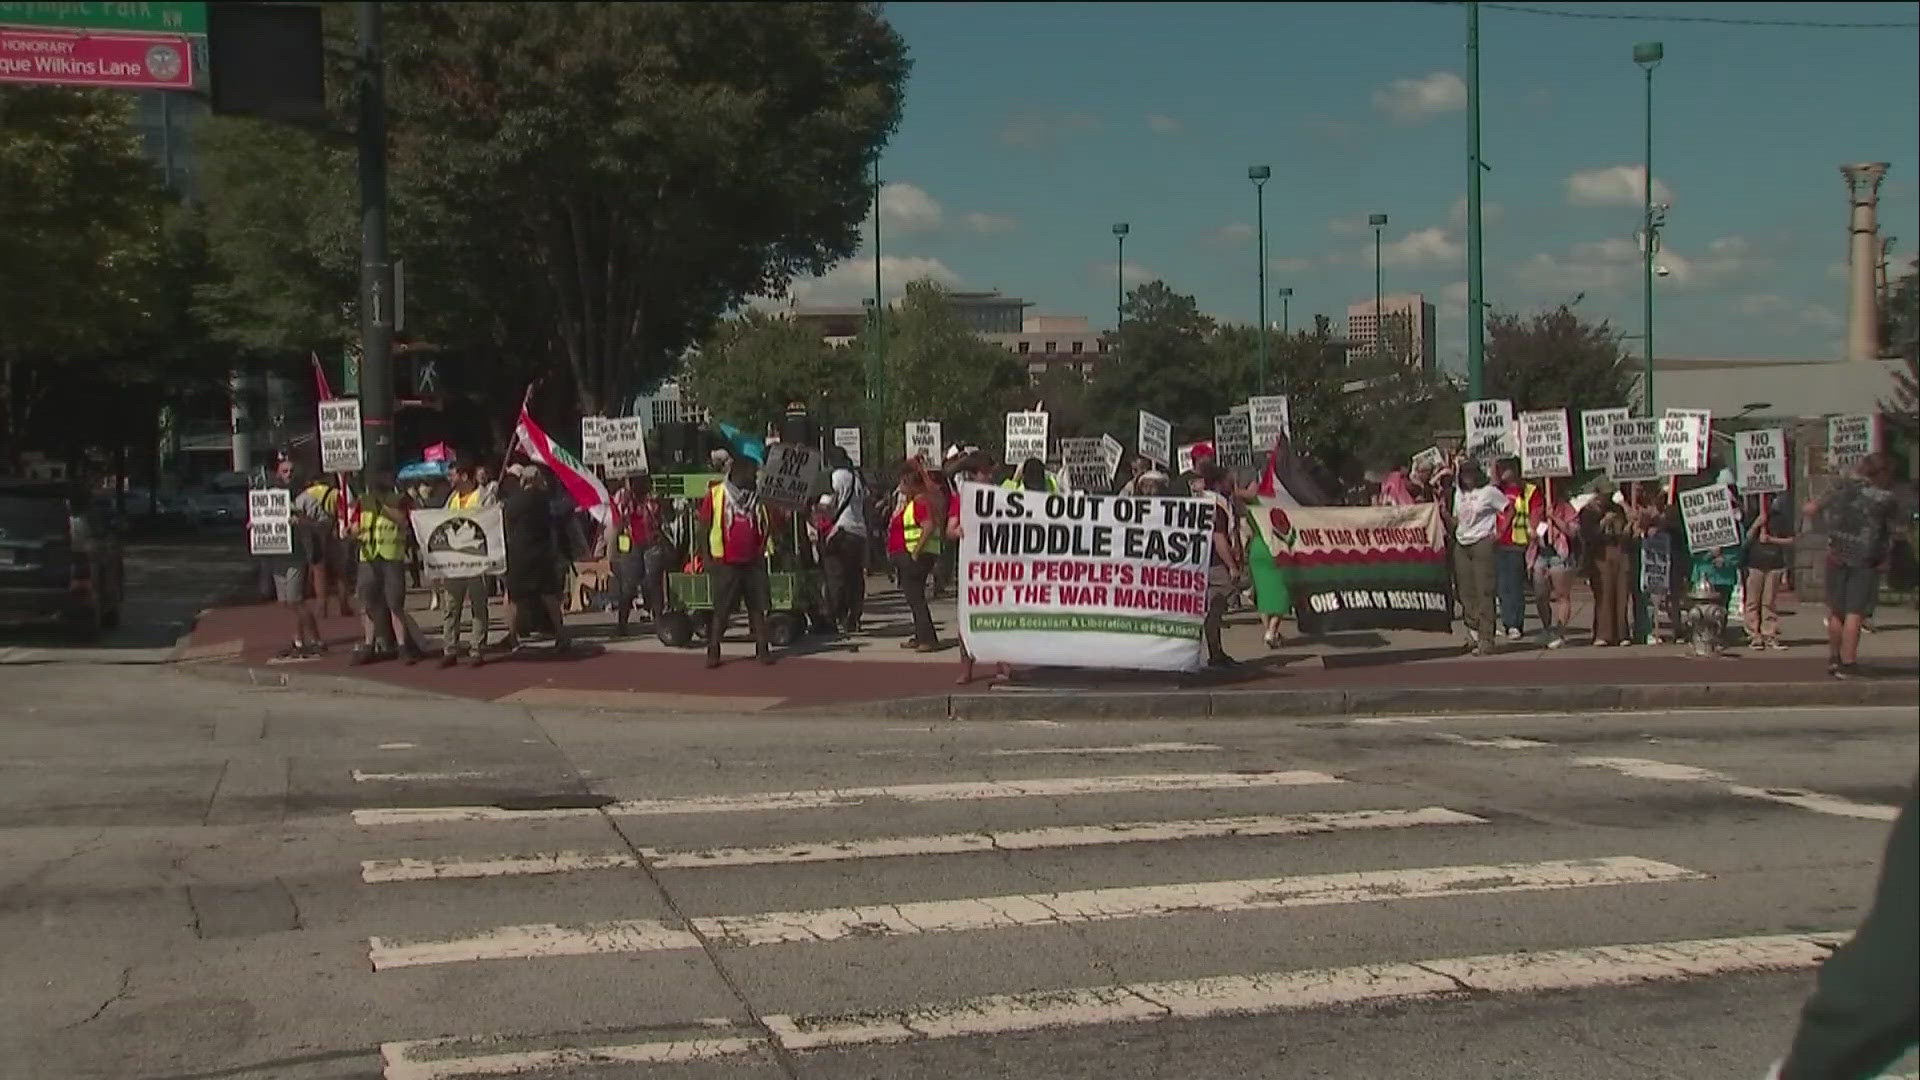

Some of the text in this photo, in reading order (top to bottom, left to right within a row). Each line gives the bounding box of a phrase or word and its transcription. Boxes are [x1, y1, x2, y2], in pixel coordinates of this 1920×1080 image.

[3, 40, 75, 53] HONORARY
[35, 56, 96, 75] Wilkins
[99, 59, 141, 76] Lane
[339, 407, 357, 419] THE
[1480, 403, 1497, 414] NO
[620, 422, 638, 431] OUT
[1009, 416, 1043, 427] END THE
[1474, 415, 1503, 428] WAR
[1528, 422, 1559, 431] HANDS
[1586, 415, 1605, 427] END
[1665, 420, 1684, 431] NO
[916, 425, 930, 434] NO
[1613, 423, 1634, 436] END
[1637, 421, 1656, 435] THE
[606, 433, 618, 441] OF
[621, 432, 637, 440] THE
[912, 434, 935, 445] WAR
[1526, 432, 1562, 444] OFF THE
[1659, 431, 1689, 444] WAR
[1751, 433, 1769, 446] NO
[324, 438, 358, 451] WAR ON
[1010, 439, 1043, 449] WAR ON
[1526, 444, 1564, 457] MIDDLE
[607, 449, 640, 459] MIDDLE
[782, 448, 809, 465] END
[1614, 451, 1638, 462] WAR
[1641, 449, 1655, 461] ON
[1667, 448, 1682, 458] ON
[1745, 447, 1776, 460] WAR
[779, 461, 800, 478] ALL
[1754, 463, 1768, 475] ON
[1747, 475, 1776, 488] IRAN!
[252, 494, 285, 506] END THE
[1683, 488, 1727, 508] END THE
[975, 489, 1214, 531] U.S. OUT OF THE
[254, 522, 287, 535] WAR ON
[1688, 517, 1732, 534] WAR ON
[1300, 526, 1430, 546] ONE YEAR OF GENOCIDE
[979, 523, 1207, 565] MIDDLE EAST
[968, 561, 1205, 592] FUND PEOPLE'S NEEDS
[968, 585, 1008, 606] NOT
[1013, 585, 1051, 605] THE
[1059, 587, 1108, 608] WAR
[1310, 591, 1340, 613] ONE
[1340, 590, 1375, 609] YEAR
[1374, 590, 1388, 609] OF
[976, 616, 1001, 630] Party
[1003, 617, 1018, 627] for
[1019, 617, 1070, 629] Socialism
[1071, 617, 1080, 628] &
[1081, 618, 1132, 631] Liberation
